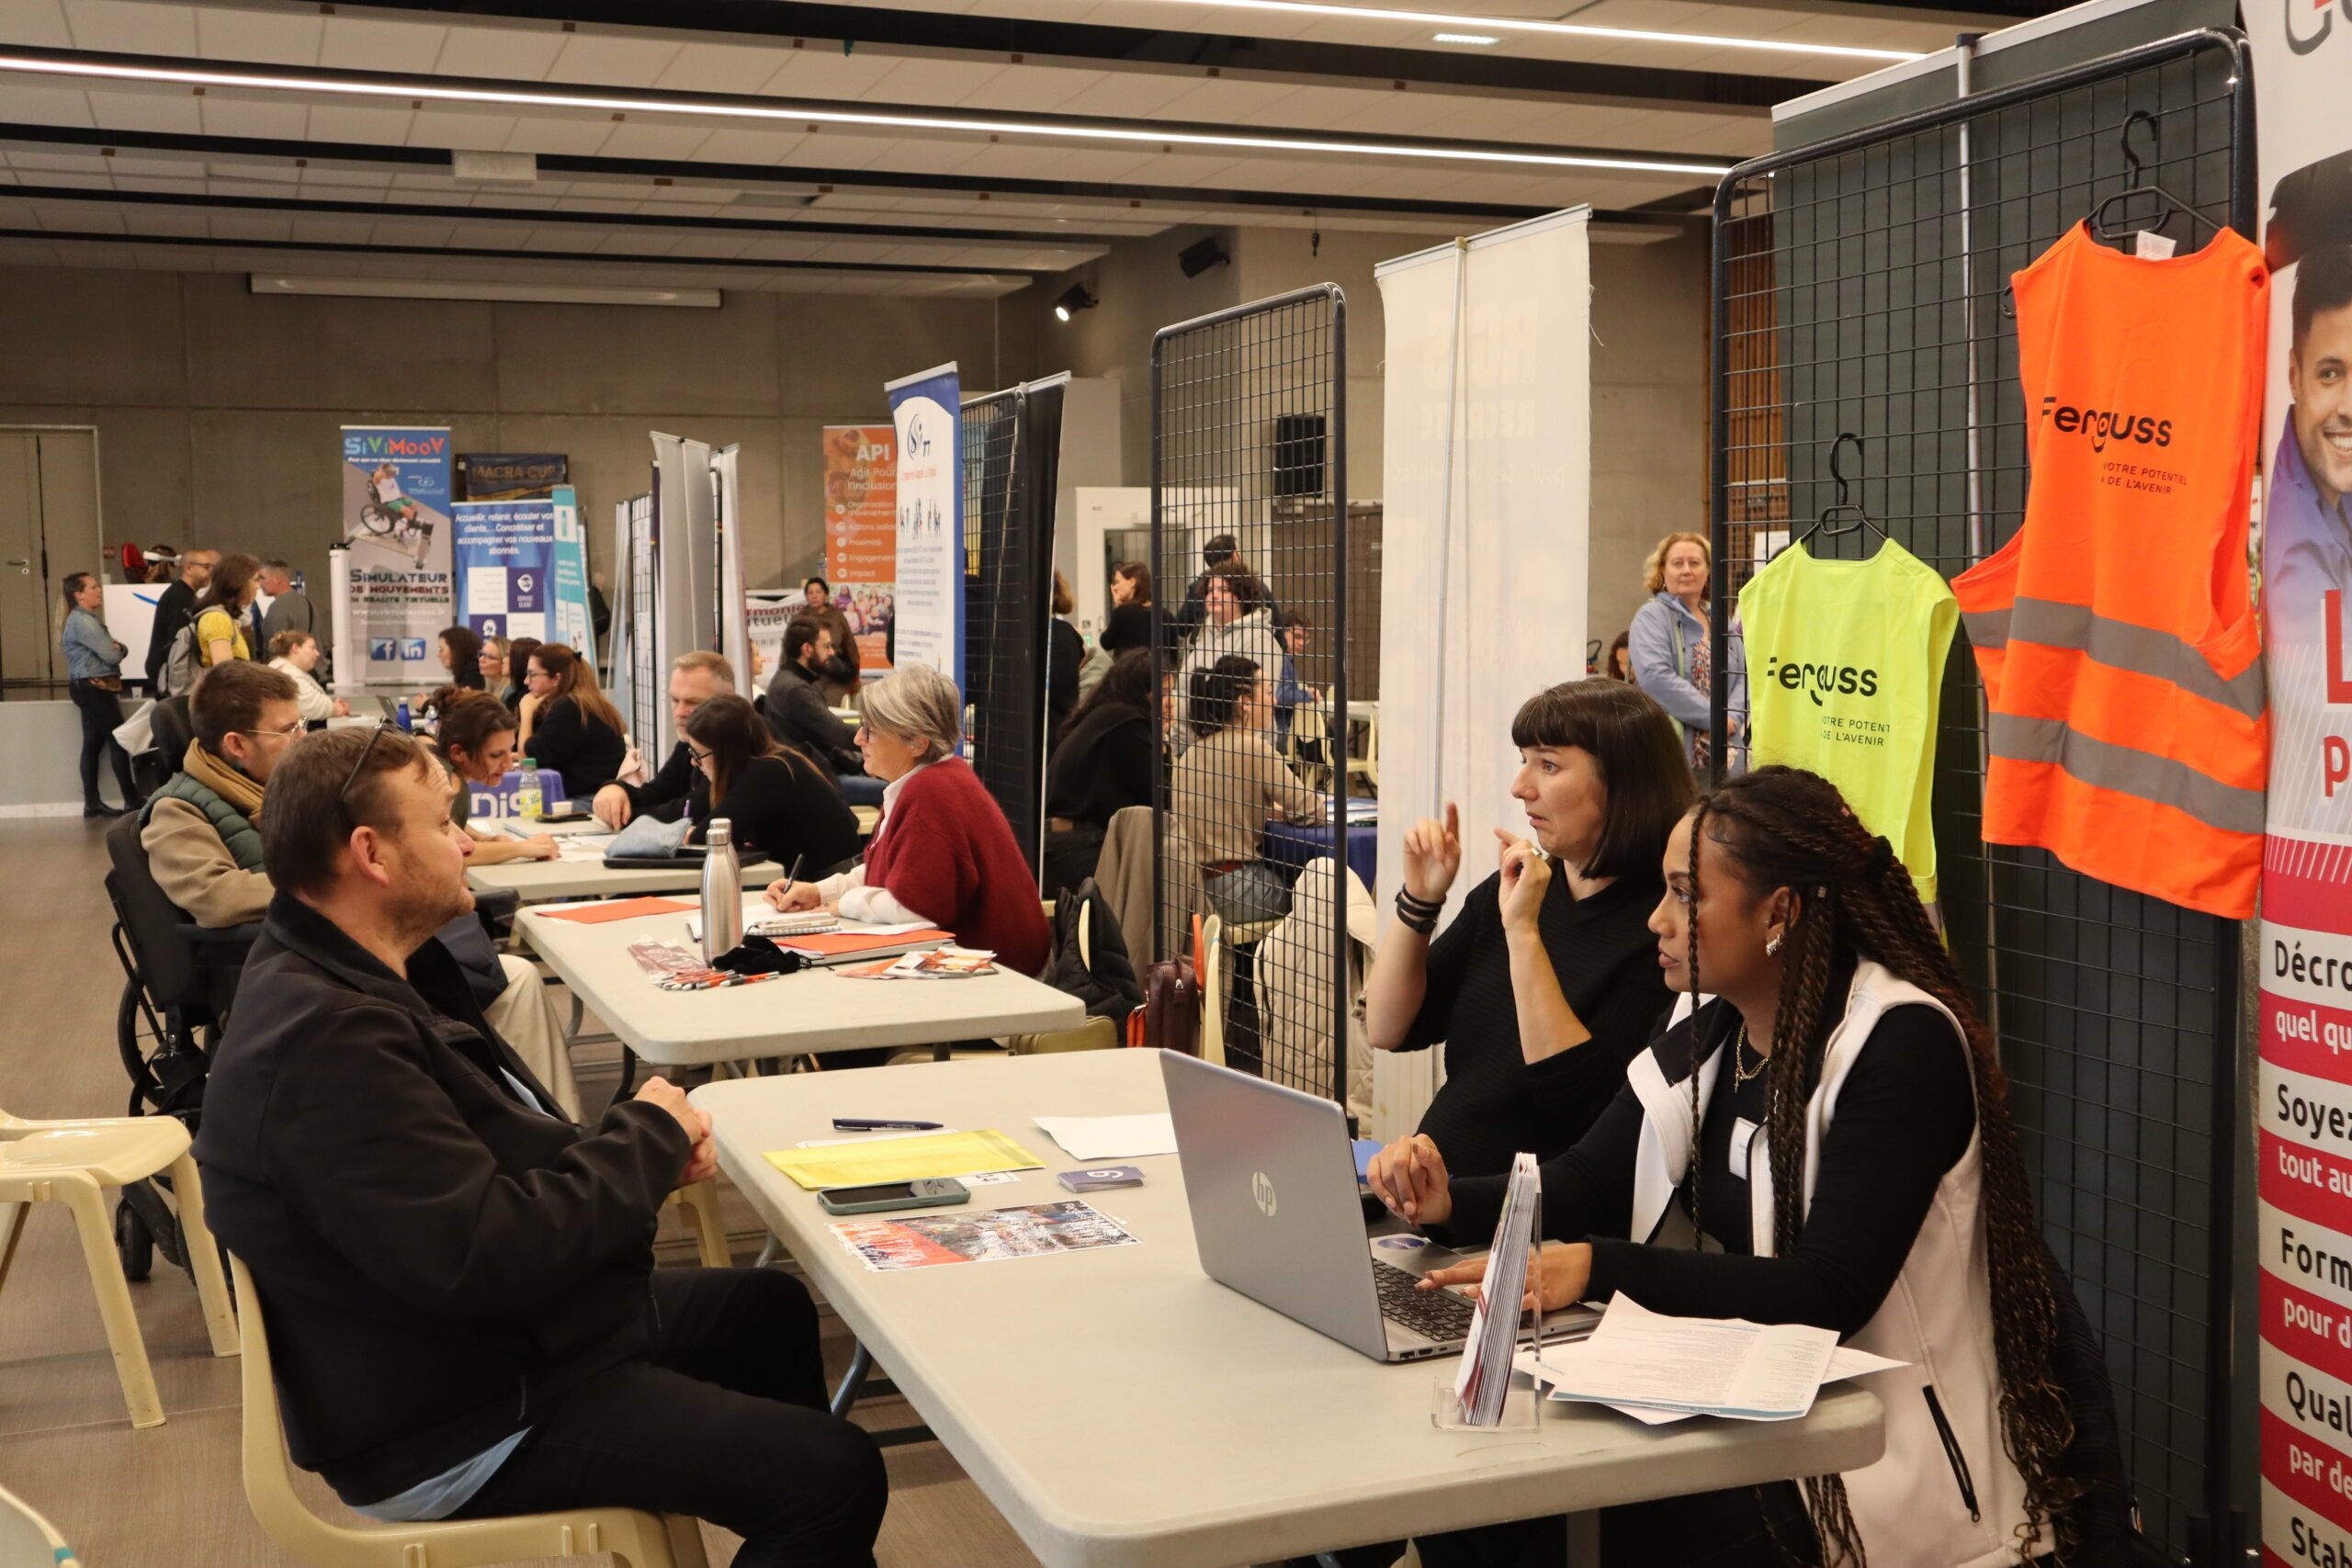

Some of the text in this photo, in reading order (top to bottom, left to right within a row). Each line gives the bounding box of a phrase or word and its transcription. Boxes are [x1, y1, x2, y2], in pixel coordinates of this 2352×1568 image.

[2042, 397, 2172, 453] Ferguss
[855, 444, 889, 461] API
[850, 468, 870, 479] Agir
[2103, 462, 2188, 485] VOTRE POTENTIEL
[2108, 476, 2121, 486] DE
[2126, 479, 2172, 495] L'AVENIR
[1822, 716, 1843, 727] OTRE
[1836, 732, 1883, 746] L'AVENIR
[2276, 1010, 2319, 1043] quel
[2278, 1145, 2324, 1188] tout
[1252, 1171, 1277, 1216] hp
[2283, 1297, 2333, 1338] pour
[2290, 1444, 2324, 1482] par
